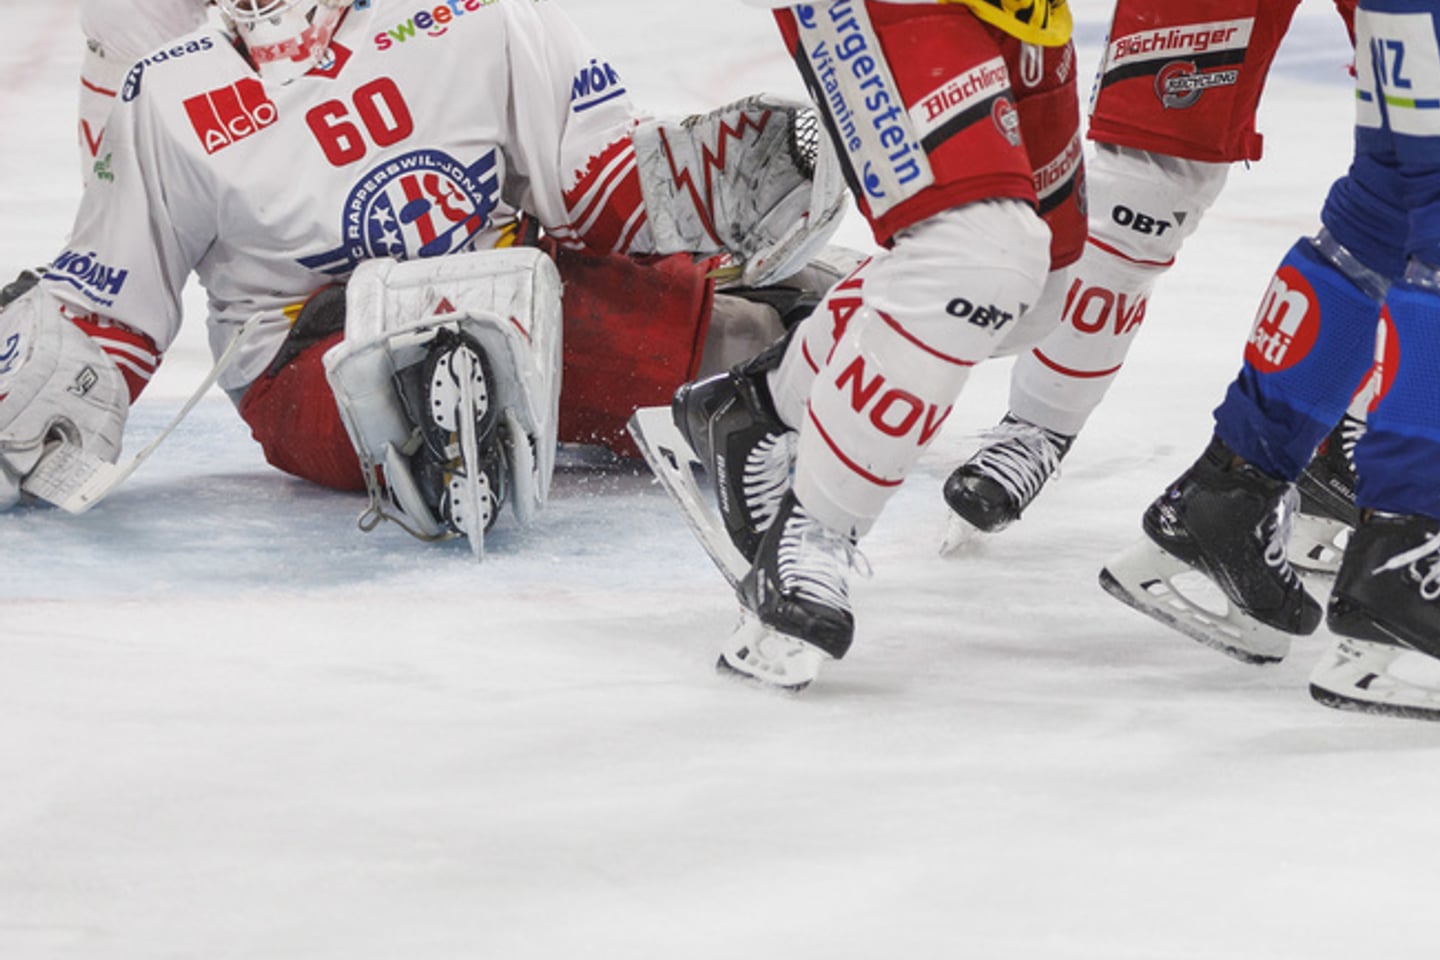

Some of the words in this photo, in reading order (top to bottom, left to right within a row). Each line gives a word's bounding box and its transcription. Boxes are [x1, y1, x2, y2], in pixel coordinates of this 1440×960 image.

[1113, 26, 1239, 61] Blöchlinger
[204, 102, 277, 152] ACO
[305, 76, 414, 168] 60
[810, 40, 862, 153] Vitamine
[1111, 204, 1173, 237] OBT
[834, 354, 954, 448] NOV
